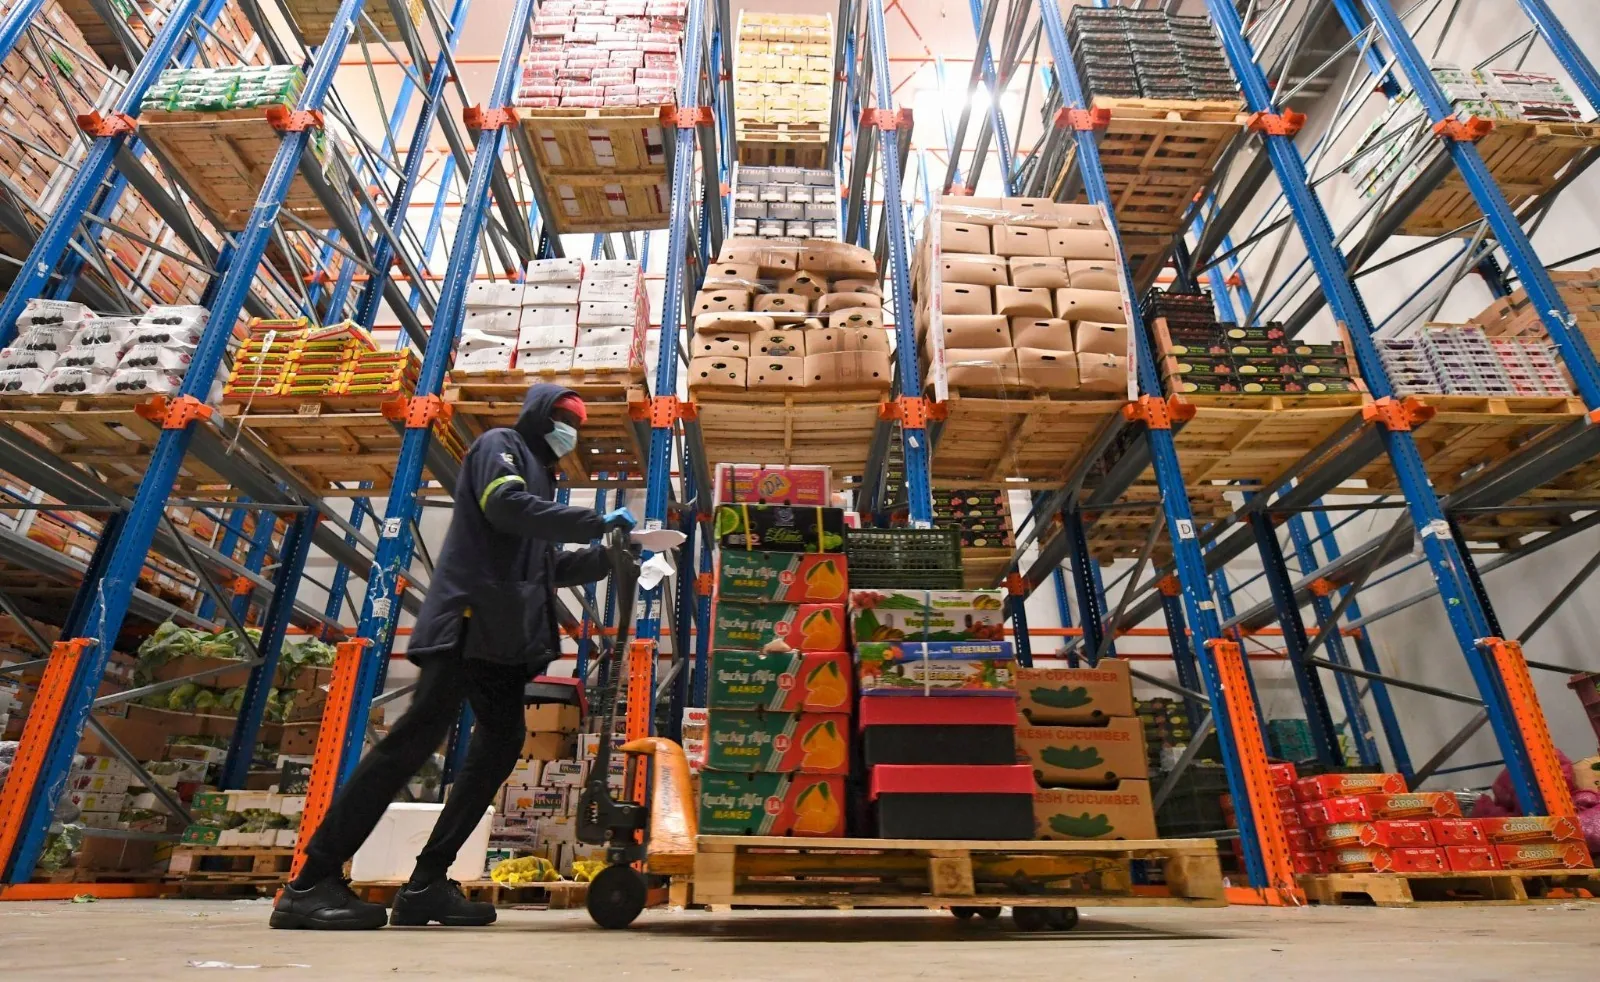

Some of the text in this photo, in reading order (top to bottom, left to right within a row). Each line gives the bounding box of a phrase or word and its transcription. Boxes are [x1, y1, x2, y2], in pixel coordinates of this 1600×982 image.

[388, 522, 398, 534] G
[1181, 524, 1191, 534] D
[951, 645, 1002, 654] VEGETABLES
[1046, 671, 1118, 682] CUCUMBER
[1056, 730, 1130, 742] CUCUMBER
[1341, 779, 1376, 787] CARROT
[1066, 794, 1140, 806] CUCUMBER
[1387, 800, 1424, 808] CARROT
[1503, 823, 1544, 832] CARROT
[1517, 850, 1556, 859] CARROT
